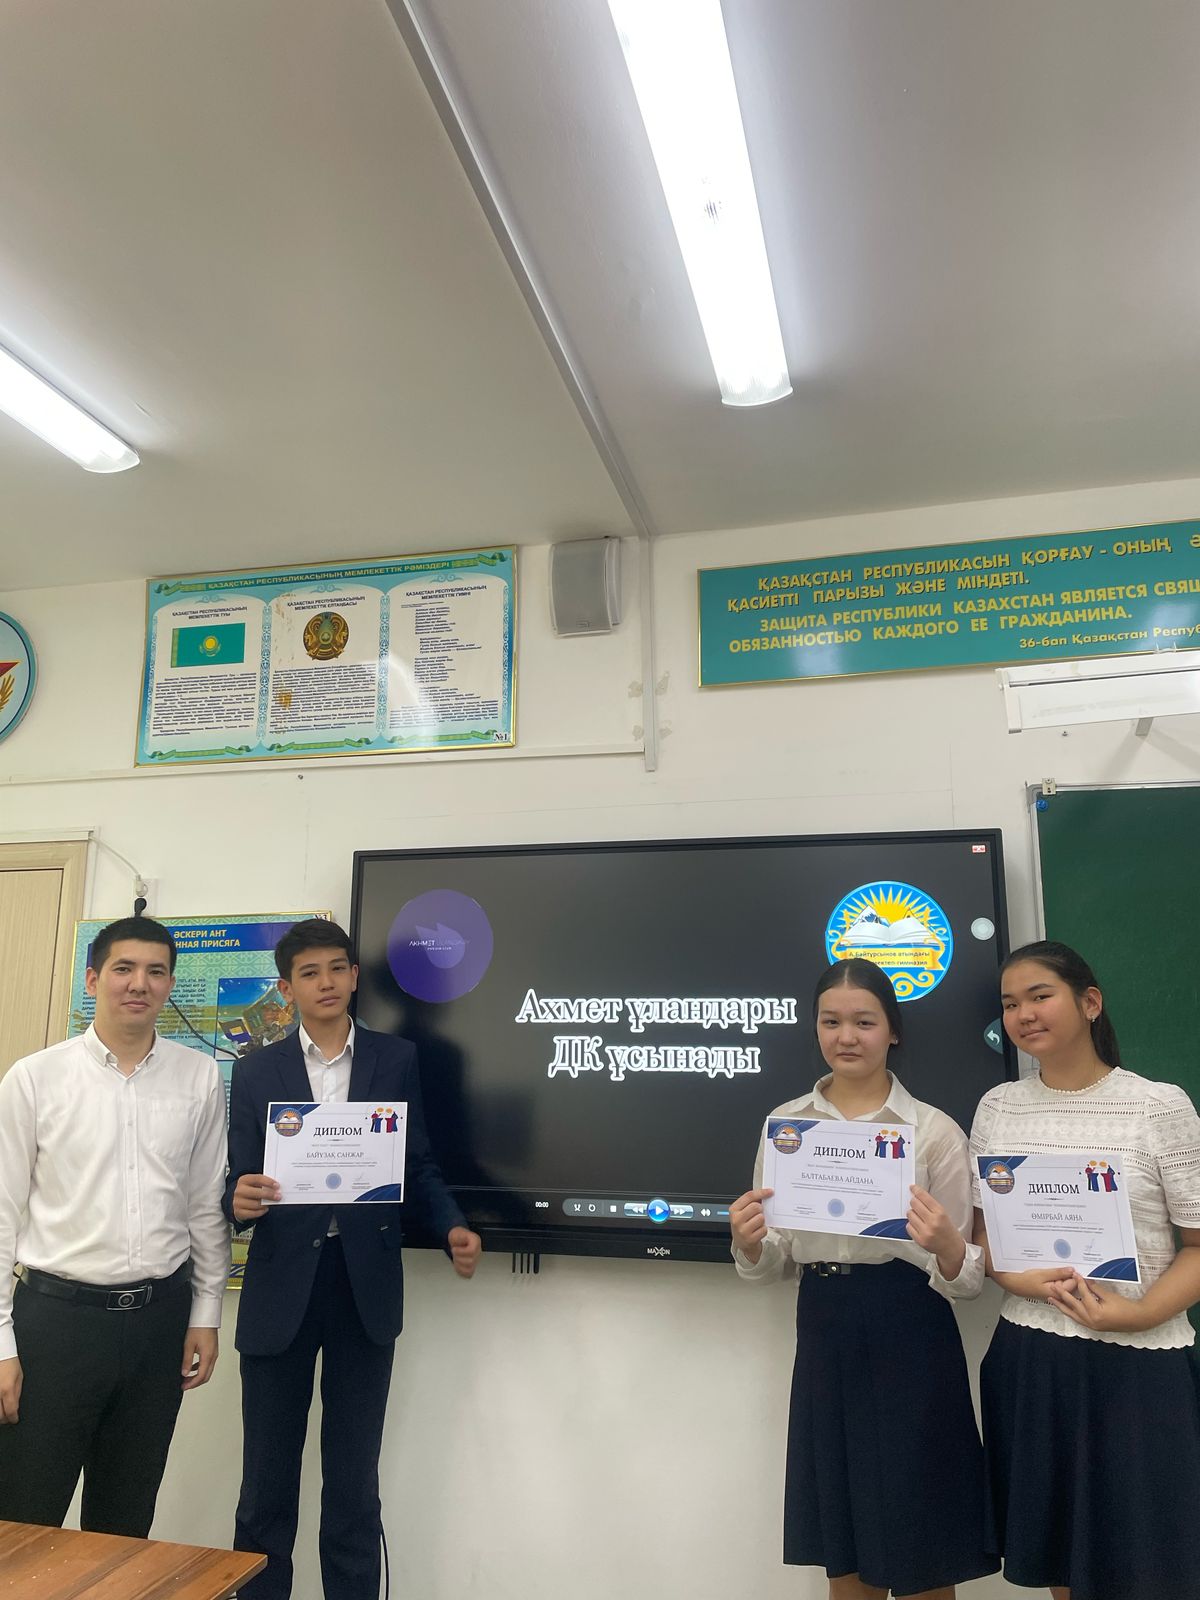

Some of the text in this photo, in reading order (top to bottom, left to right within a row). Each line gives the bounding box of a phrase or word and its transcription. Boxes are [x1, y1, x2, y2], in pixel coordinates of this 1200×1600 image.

[758, 569, 852, 591] ҚАЗАҚСТАН
[864, 554, 1010, 580] РЕСПУБЛИКАСЫН
[1022, 545, 1094, 566] ҚОРҒАУ
[1112, 538, 1172, 556] ОНЫҢ
[728, 571, 1030, 614] ҚАСИЕТТІ ПАРЫЗЫ ЖӘНЕ МІНДЕТІ.
[760, 614, 827, 632] ЗАЩИТА
[832, 603, 942, 626] РЕСПУБЛИКИ
[954, 592, 1054, 614] КАЗАХСТАН
[1061, 584, 1147, 605] ЯВЛЯЕТСЯ
[728, 606, 1132, 653] ОБЯЗАННОСТЬЮ КАЖДОГО ЕЕ ГРАЖДАНИНА.
[1020, 634, 1067, 648] 36-бап
[1072, 630, 1148, 645] Қазақстан
[174, 930, 208, 938] ӘСКЕРИ
[202, 939, 240, 948] ПРИСЯГА
[515, 988, 623, 1023] Ахмет
[548, 1035, 604, 1079] ДК
[314, 1126, 362, 1137] ДИПЛОМ
[814, 1146, 866, 1159] ДИПЛОМ
[801, 1172, 874, 1184] БАЛТАБАЕВА АЙДАНА
[1028, 1183, 1080, 1195] ДИПЛОМ
[1064, 1214, 1083, 1222] АЯНА
